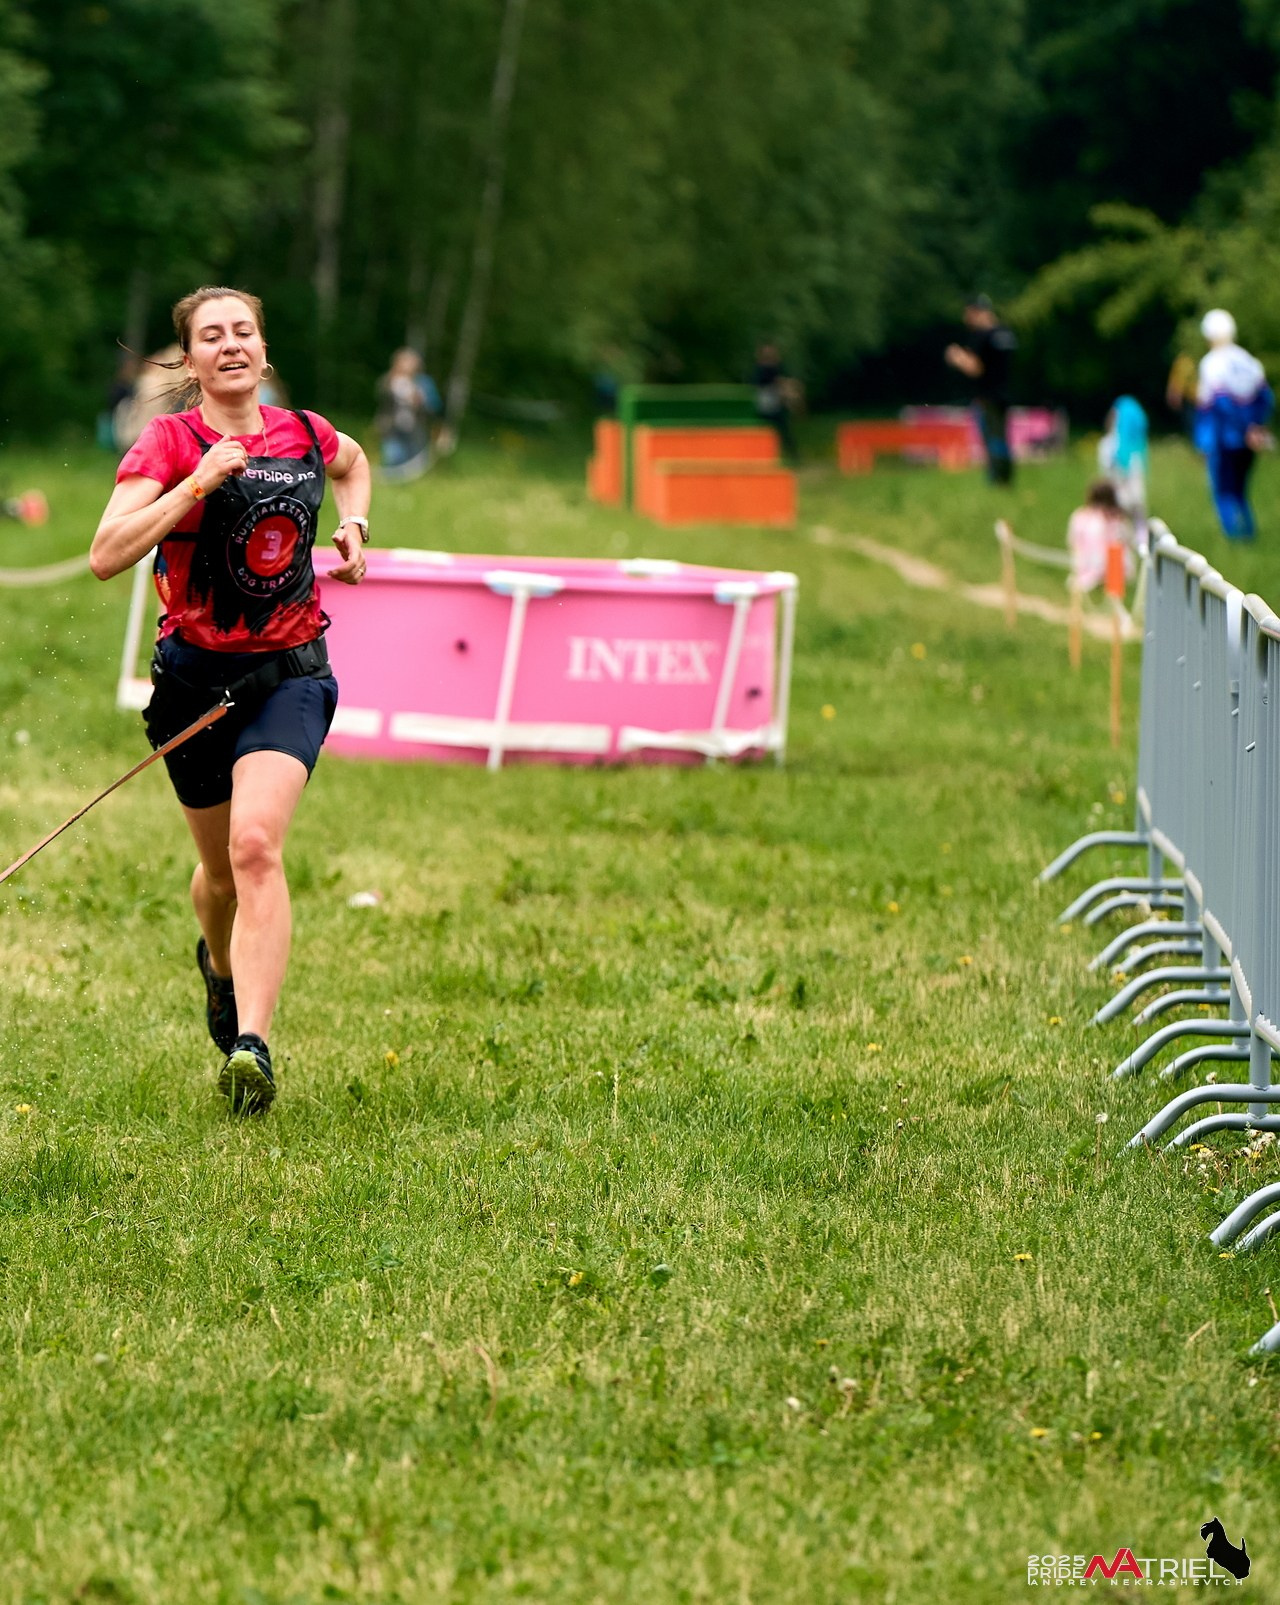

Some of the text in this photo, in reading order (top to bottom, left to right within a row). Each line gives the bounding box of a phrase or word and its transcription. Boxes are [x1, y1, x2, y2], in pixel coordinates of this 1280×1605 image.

[261, 530, 282, 560] 3
[238, 567, 296, 589] DOG TRAIL
[566, 635, 716, 684] INTEX
